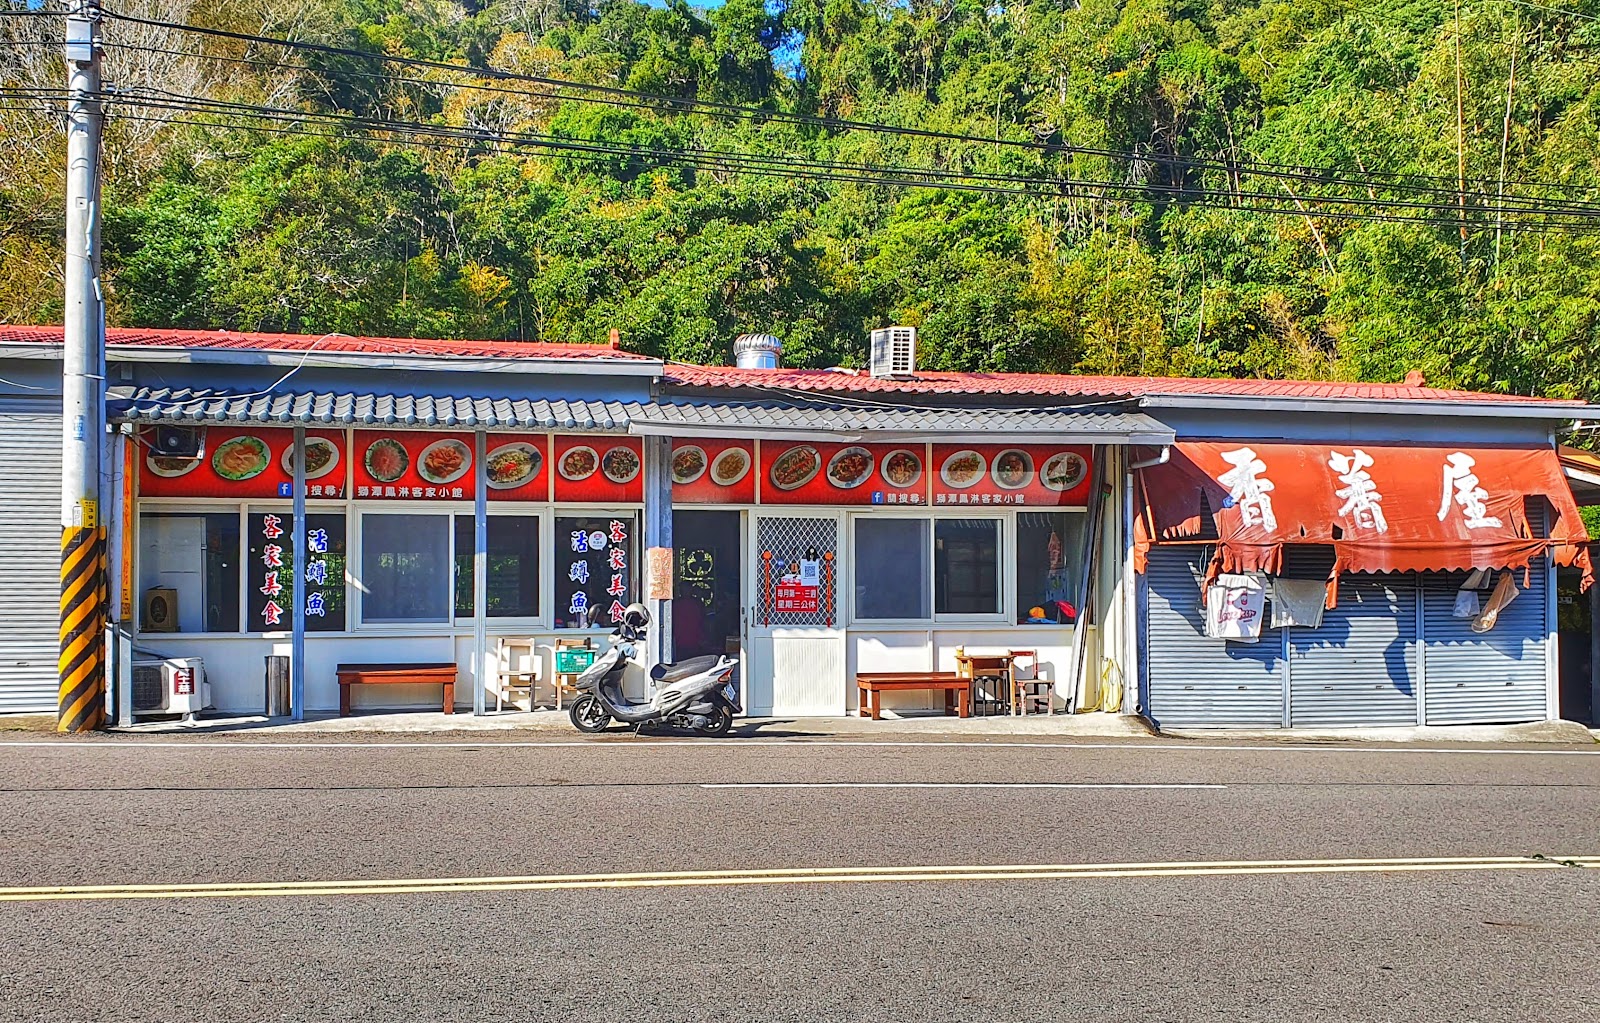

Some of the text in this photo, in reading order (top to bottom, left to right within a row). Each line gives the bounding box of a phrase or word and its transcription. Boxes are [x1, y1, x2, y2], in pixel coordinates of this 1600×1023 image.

[260, 514, 283, 625] 客家美食
[305, 528, 328, 617] 活鱒魚
[568, 530, 590, 615] 活鱒魚
[606, 520, 627, 623] 客家美食
[777, 600, 817, 609] 星期三公休
